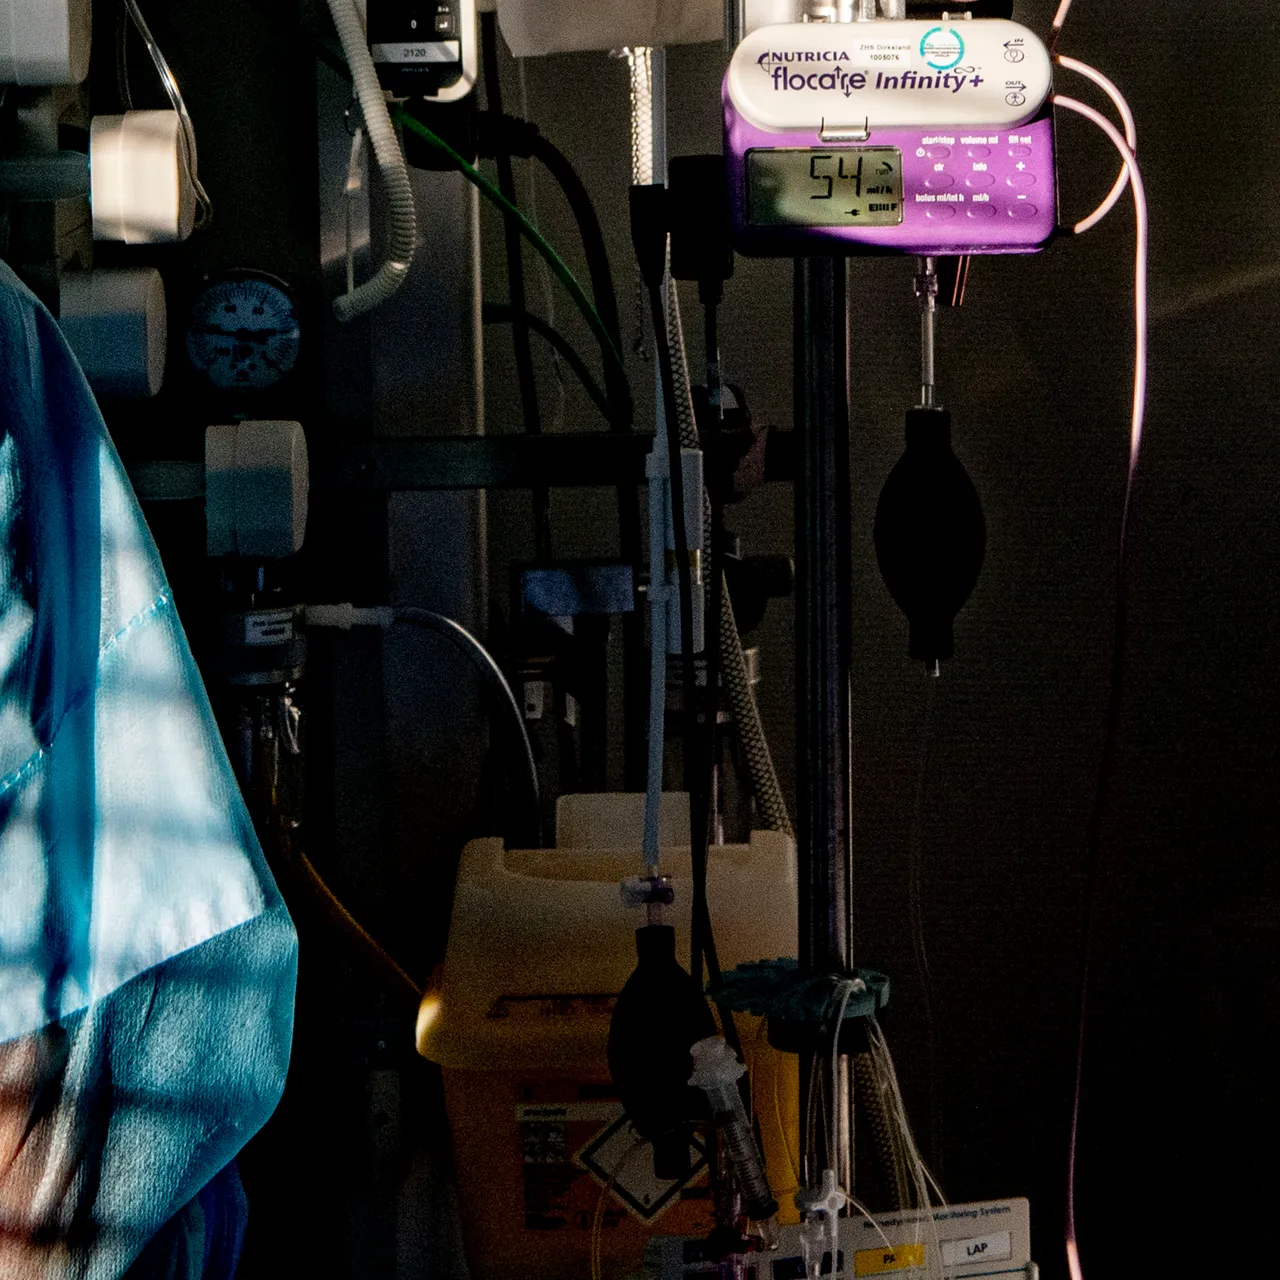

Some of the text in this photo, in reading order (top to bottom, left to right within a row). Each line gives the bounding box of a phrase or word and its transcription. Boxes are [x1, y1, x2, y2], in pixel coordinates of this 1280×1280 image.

[771, 51, 850, 62] NUTRICIA
[960, 136, 987, 145] volume
[1019, 135, 1032, 144] set
[875, 168, 889, 176] run
[809, 155, 863, 200] 54
[866, 185, 893, 194] ml/h
[915, 193, 936, 202] bolus
[972, 193, 990, 202] ml/h
[979, 1205, 1011, 1218] System
[966, 1242, 989, 1256] LAP
